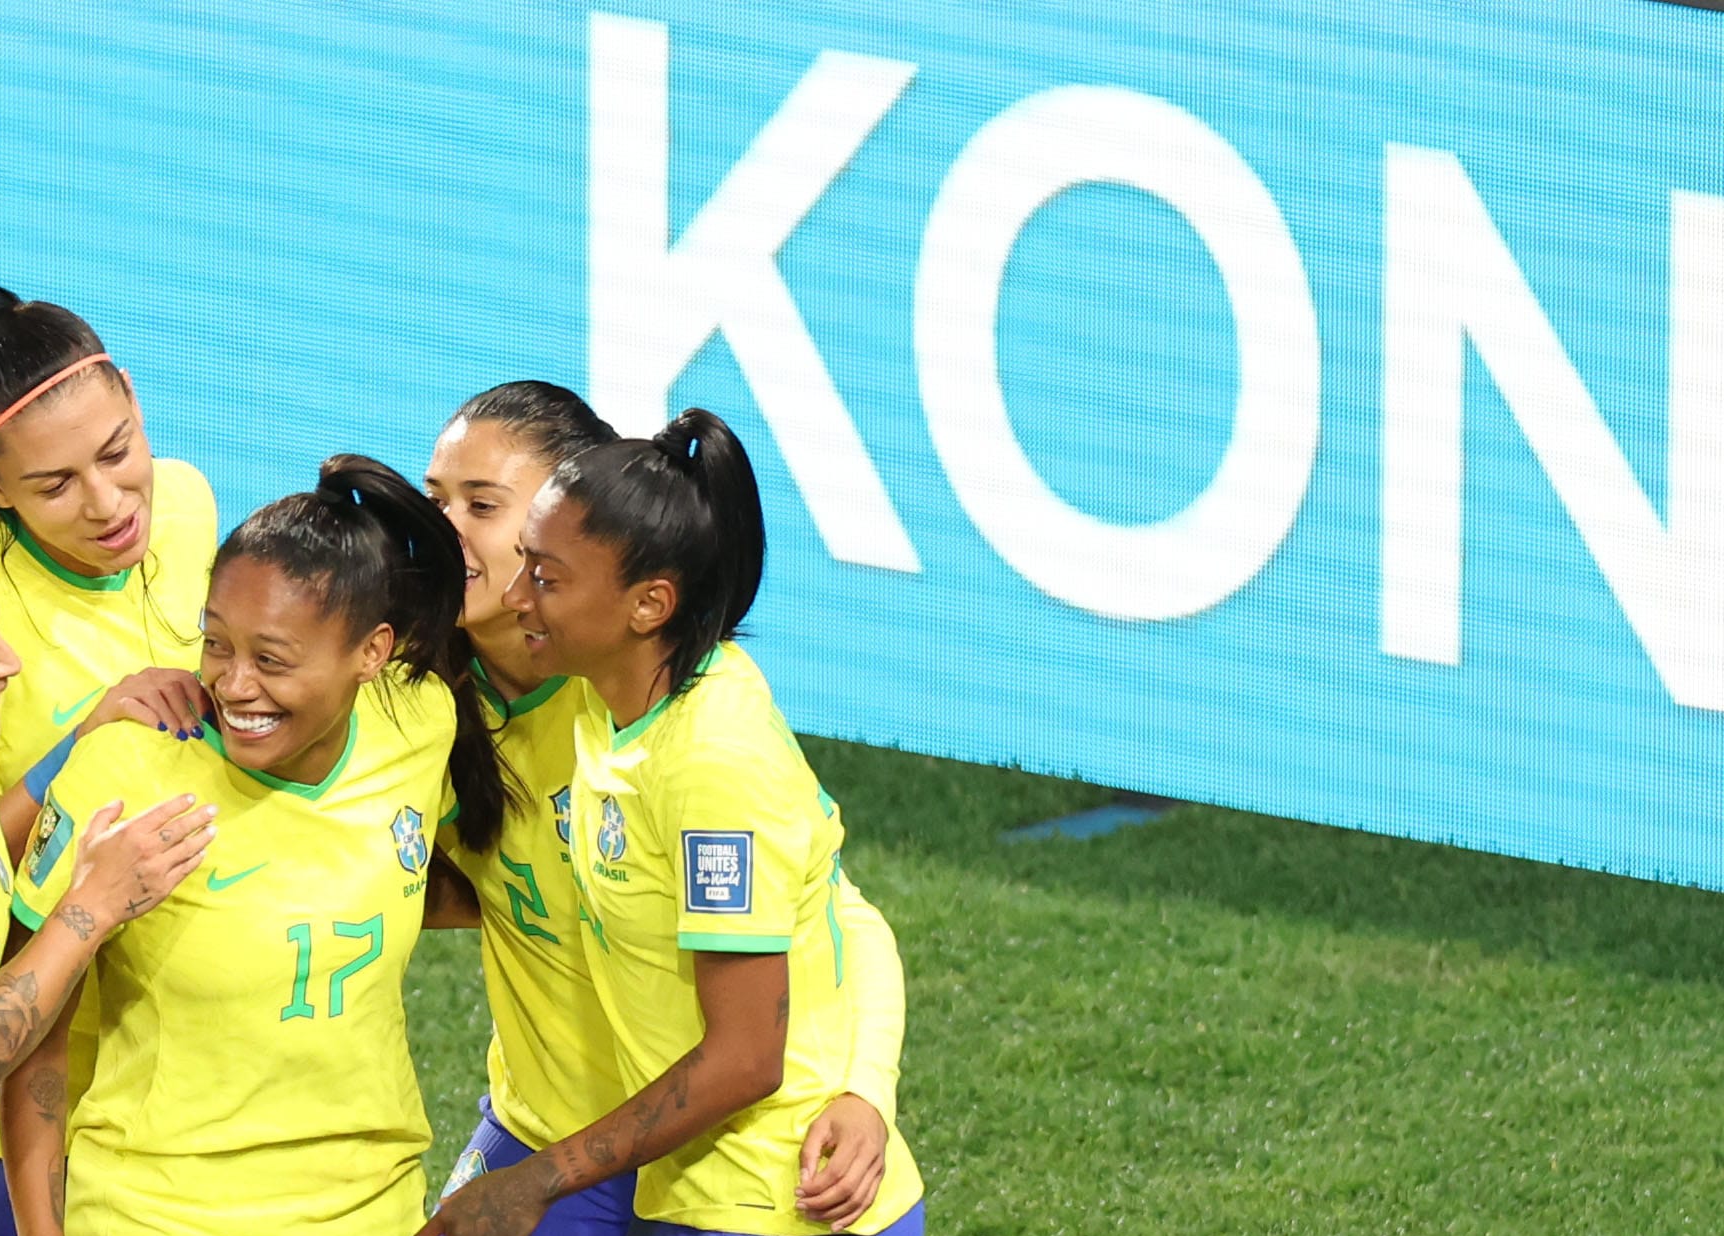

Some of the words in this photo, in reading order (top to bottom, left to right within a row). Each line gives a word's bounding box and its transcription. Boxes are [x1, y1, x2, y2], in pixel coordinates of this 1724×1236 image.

[589, 10, 1724, 714] KON
[593, 861, 630, 882] BRASIL
[697, 843, 738, 856] FOOTBALL
[697, 855, 738, 872] UNITES
[499, 850, 562, 946] 2
[279, 911, 384, 1022] 17
